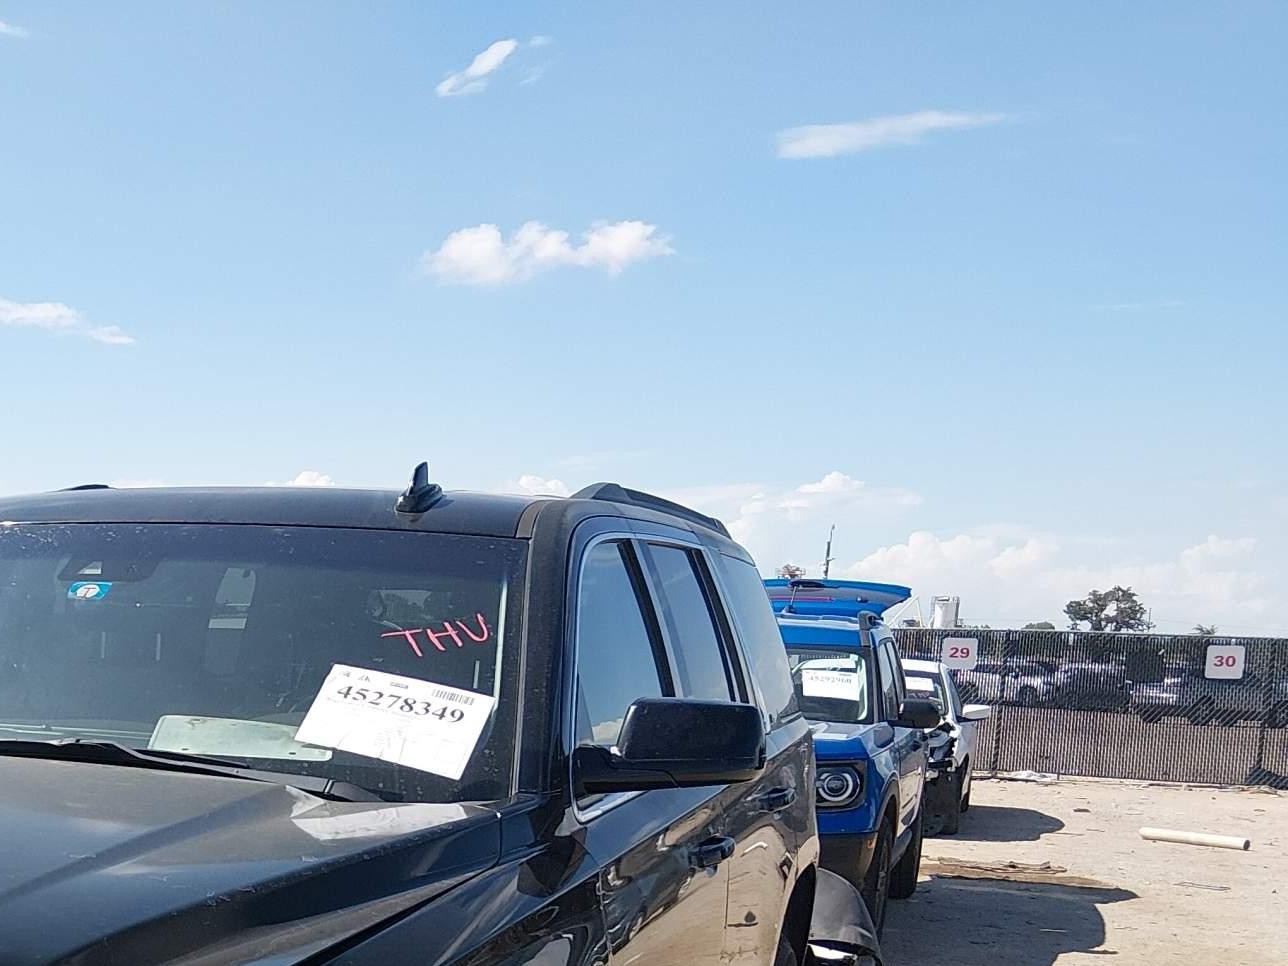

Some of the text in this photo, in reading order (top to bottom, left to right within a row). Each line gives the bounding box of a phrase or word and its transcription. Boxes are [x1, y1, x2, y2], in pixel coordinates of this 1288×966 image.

[949, 646, 970, 659] 29
[1213, 655, 1236, 668] 30
[336, 685, 465, 723] 45278349
